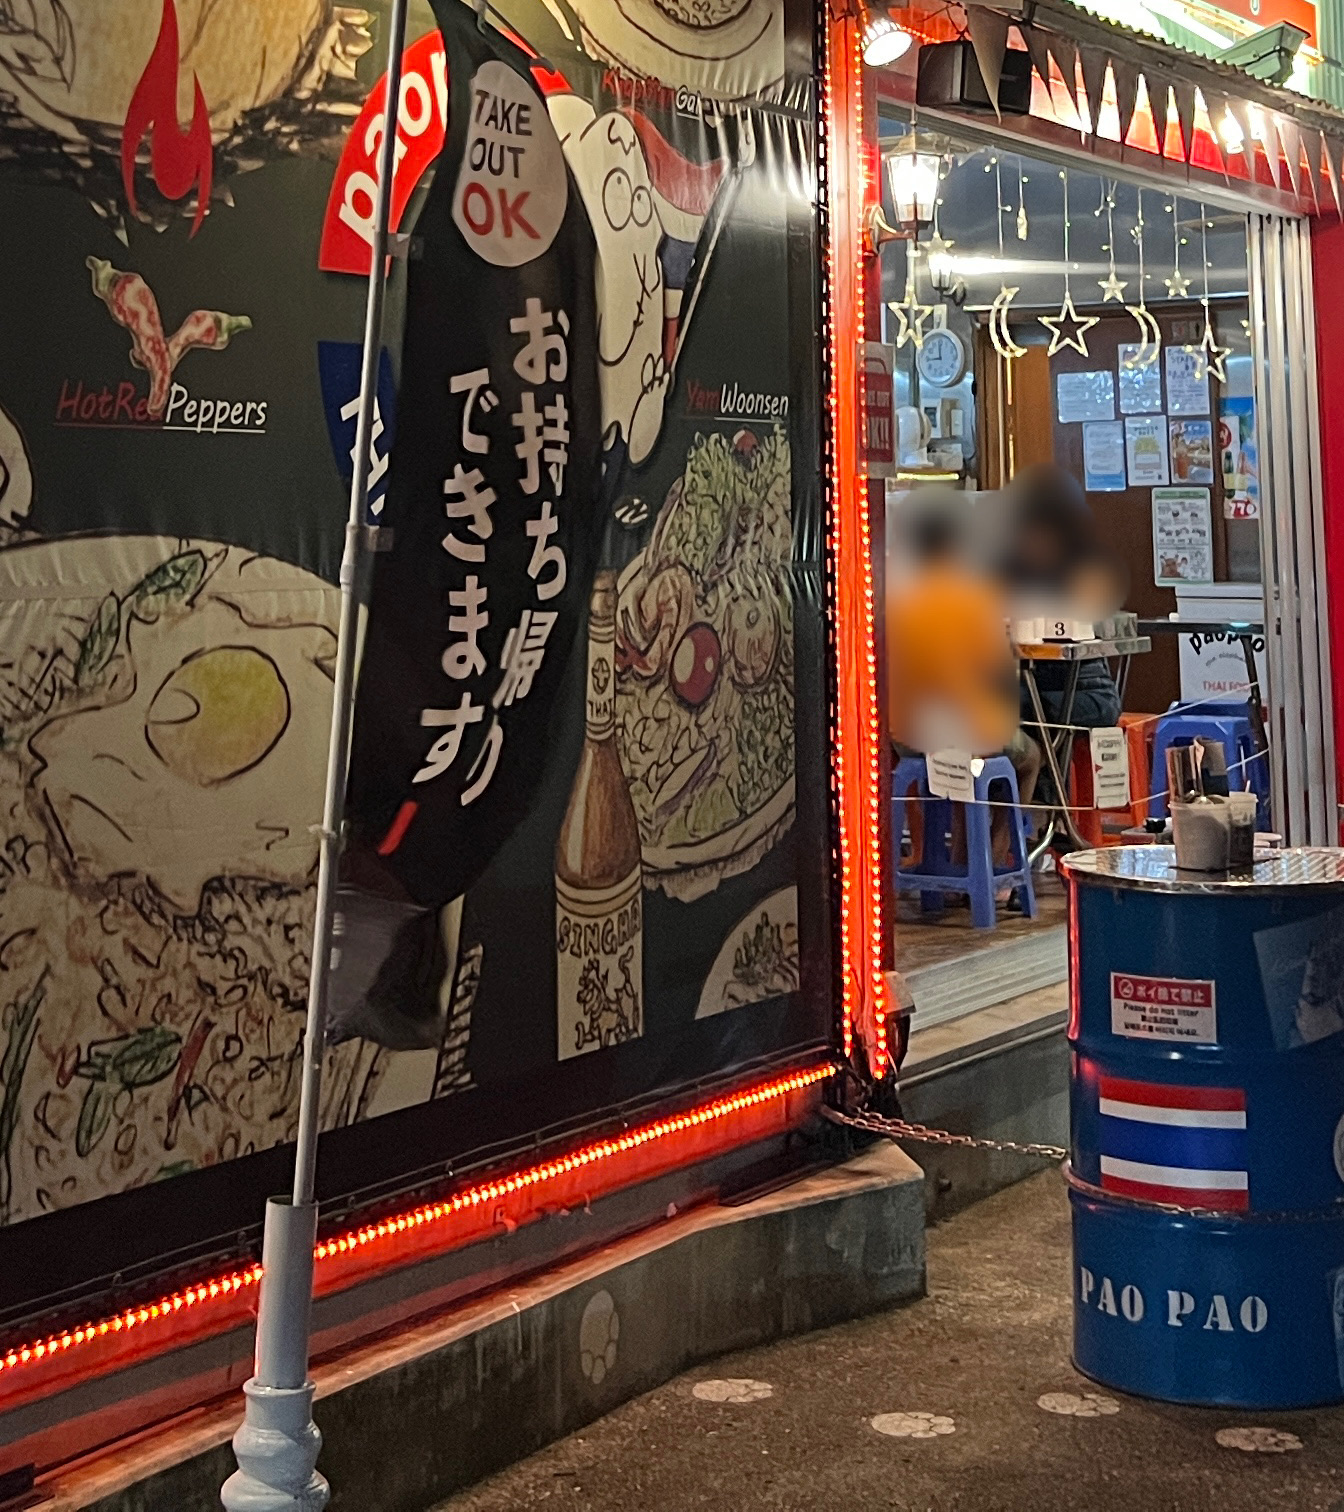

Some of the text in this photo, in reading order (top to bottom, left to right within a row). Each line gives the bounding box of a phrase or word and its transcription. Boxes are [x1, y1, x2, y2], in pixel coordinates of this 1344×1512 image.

[474, 90, 532, 138] TAKE
[470, 143, 525, 179] OUT
[462, 181, 542, 241] OK
[412, 368, 499, 784] できます
[460, 297, 570, 807] お持ち帰り
[1054, 622, 1066, 636] 3
[1189, 632, 1265, 656] paopo
[558, 898, 641, 959] SINGHA
[1079, 1265, 1268, 1333] PAO PAO
